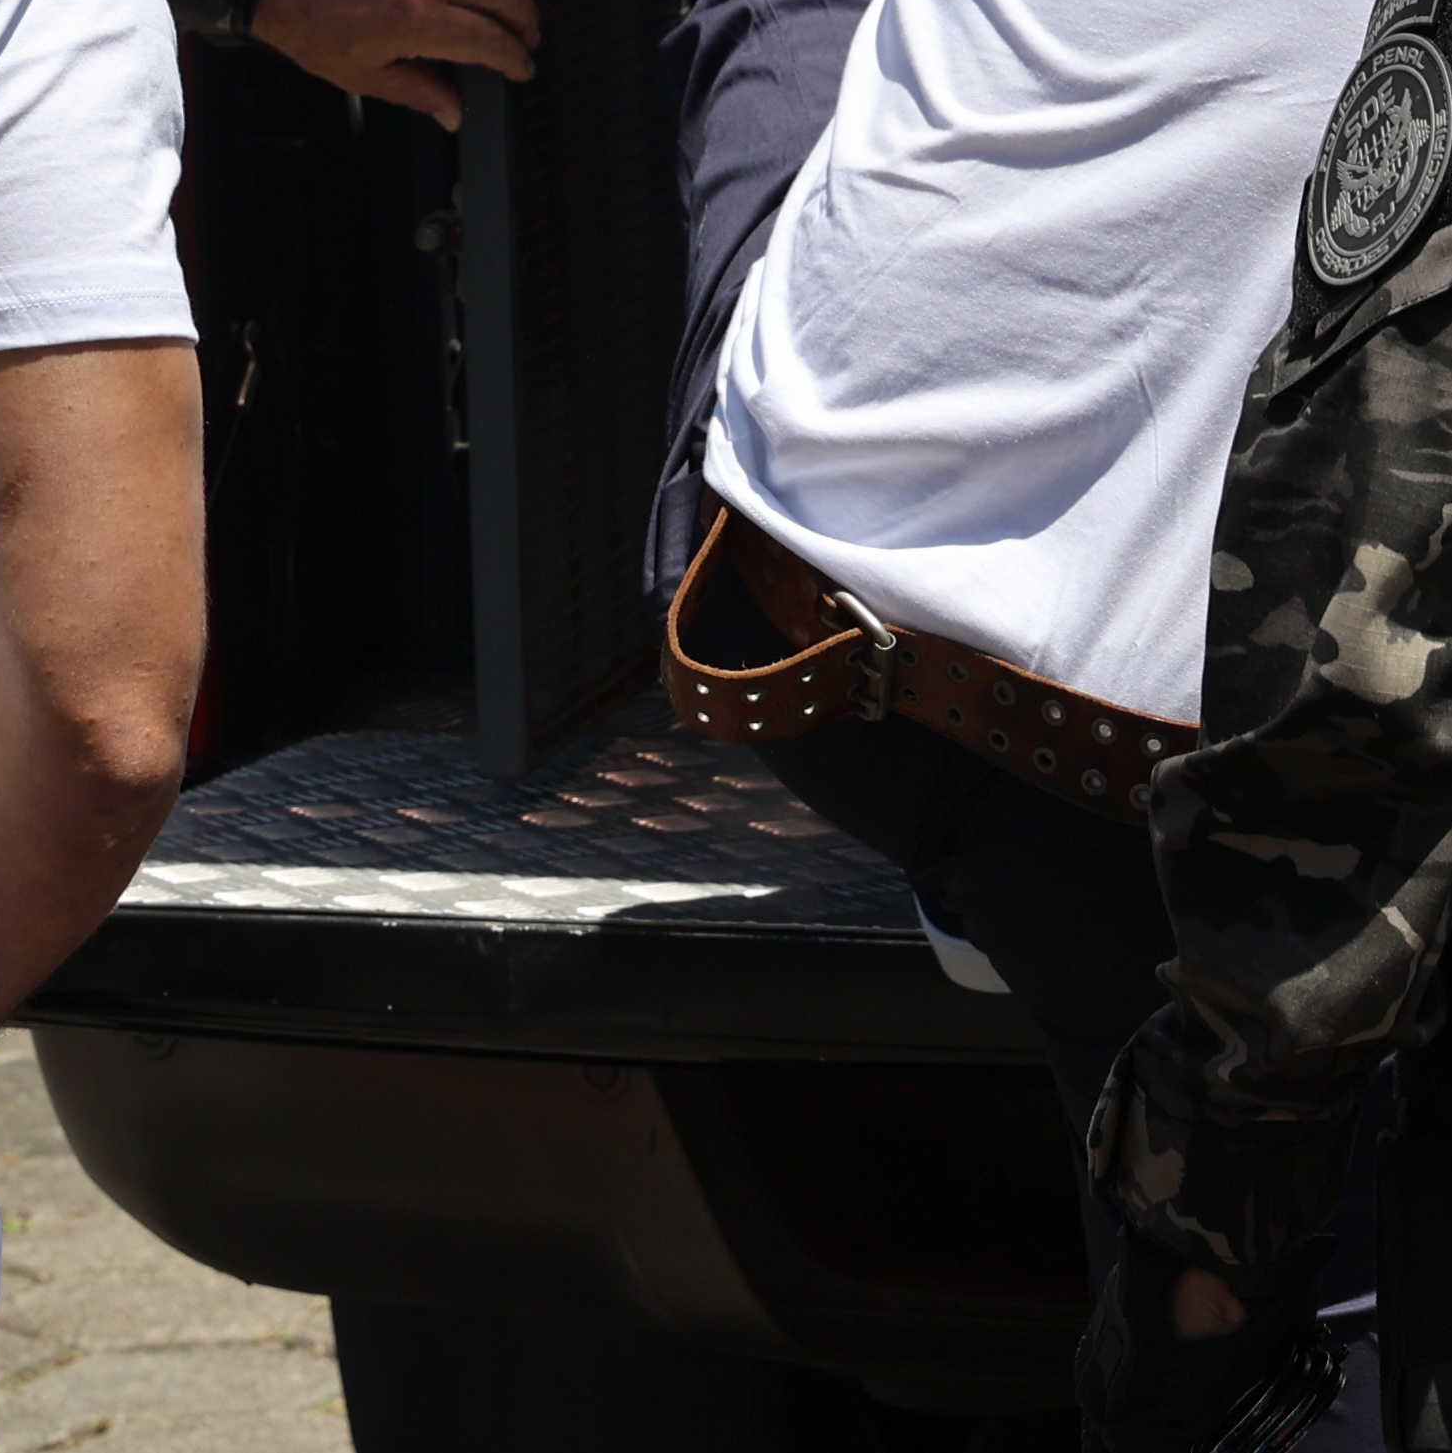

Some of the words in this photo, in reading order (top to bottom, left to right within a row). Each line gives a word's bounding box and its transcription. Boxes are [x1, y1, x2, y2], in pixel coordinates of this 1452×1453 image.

[1372, 46, 1426, 74] PENAL
[1344, 75, 1396, 151] SOE
[1370, 200, 1396, 236] RJ
